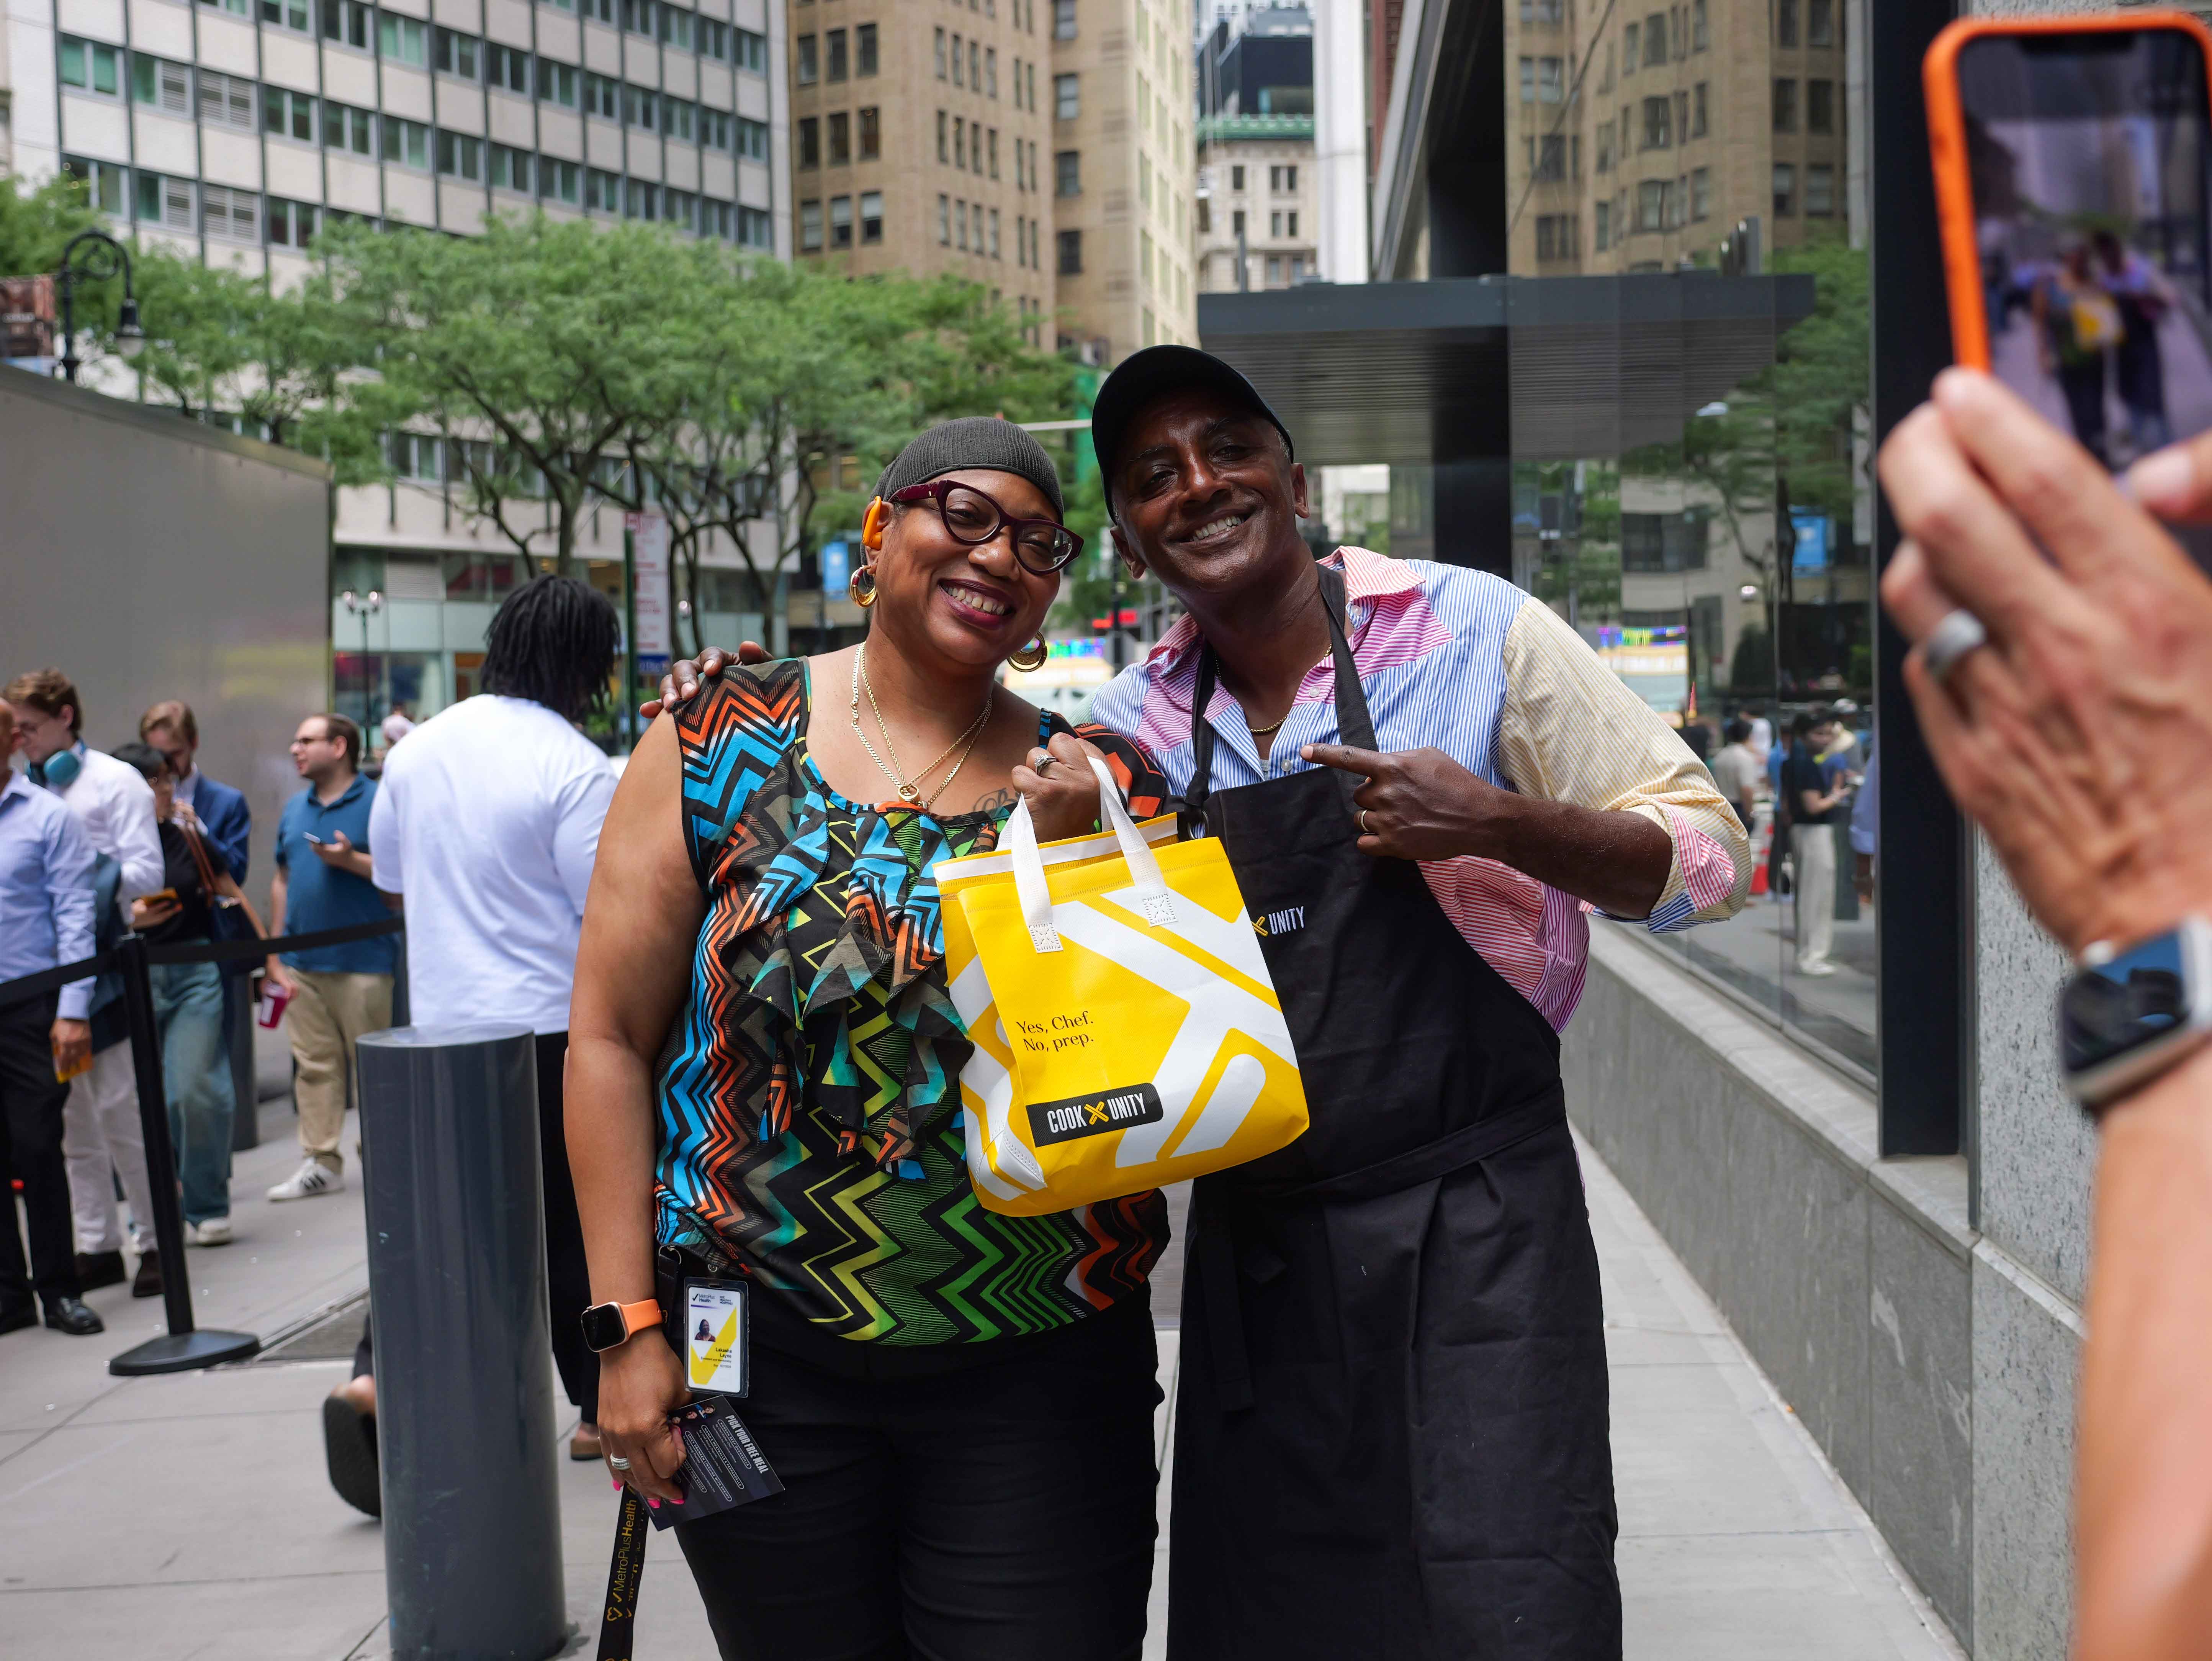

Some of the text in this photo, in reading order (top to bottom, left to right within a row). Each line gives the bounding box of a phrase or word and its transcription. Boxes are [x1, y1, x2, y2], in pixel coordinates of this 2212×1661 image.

[1268, 906, 1304, 935] UNITY
[1016, 1011, 1093, 1034] Yes, Chef.
[1023, 1034, 1094, 1052] No, prep.
[1047, 1093, 1146, 1133] COOK UNITY
[725, 1415, 769, 1474] PICK YOUR FREE MEAL
[613, 1500, 636, 1591] MetroPlusHealth
